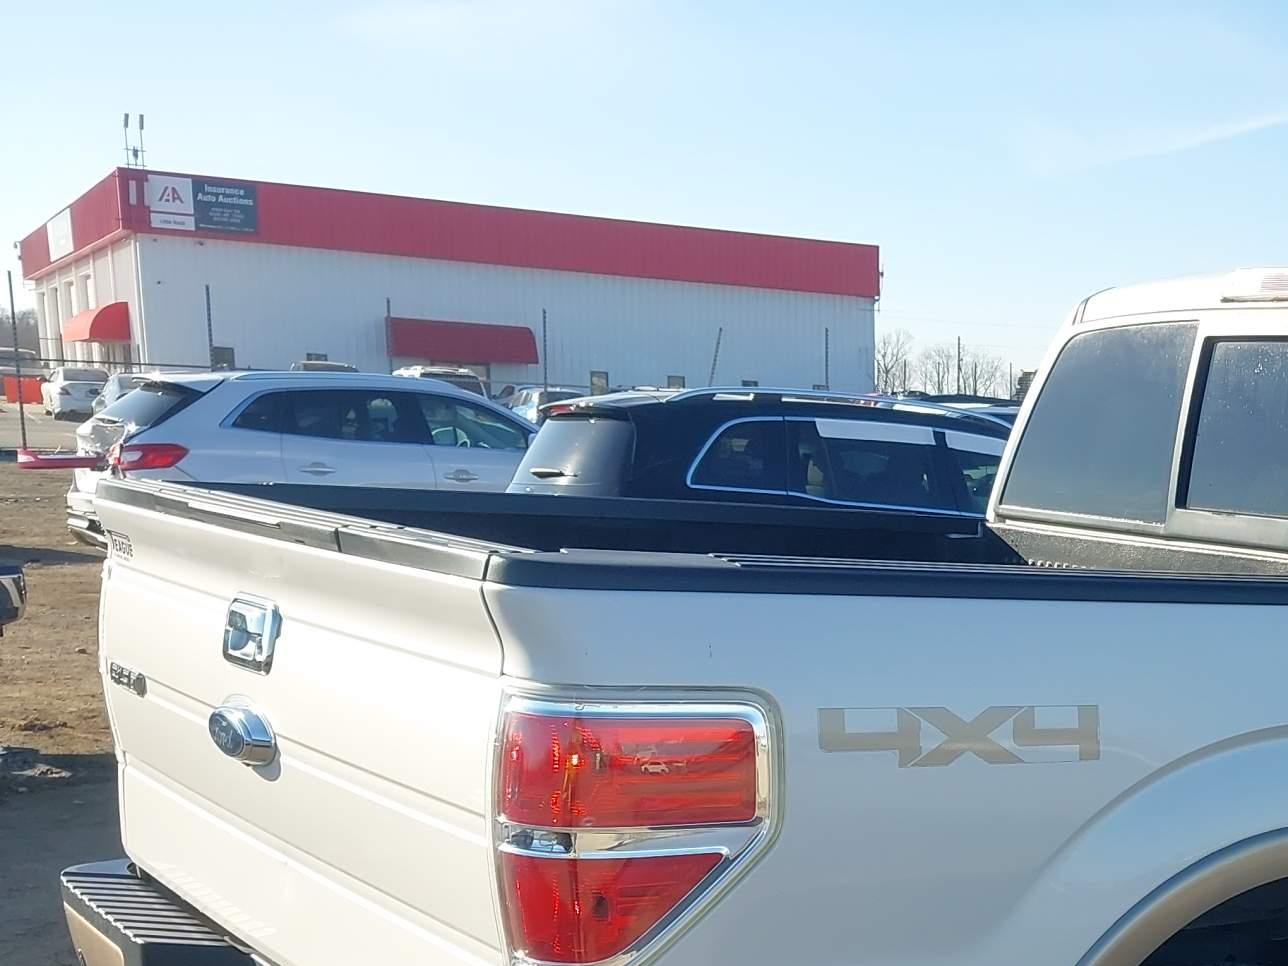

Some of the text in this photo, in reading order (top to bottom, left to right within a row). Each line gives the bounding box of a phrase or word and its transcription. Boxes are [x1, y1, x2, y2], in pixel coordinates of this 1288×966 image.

[204, 183, 244, 195] Insurance
[197, 192, 253, 206] Auto Auctions
